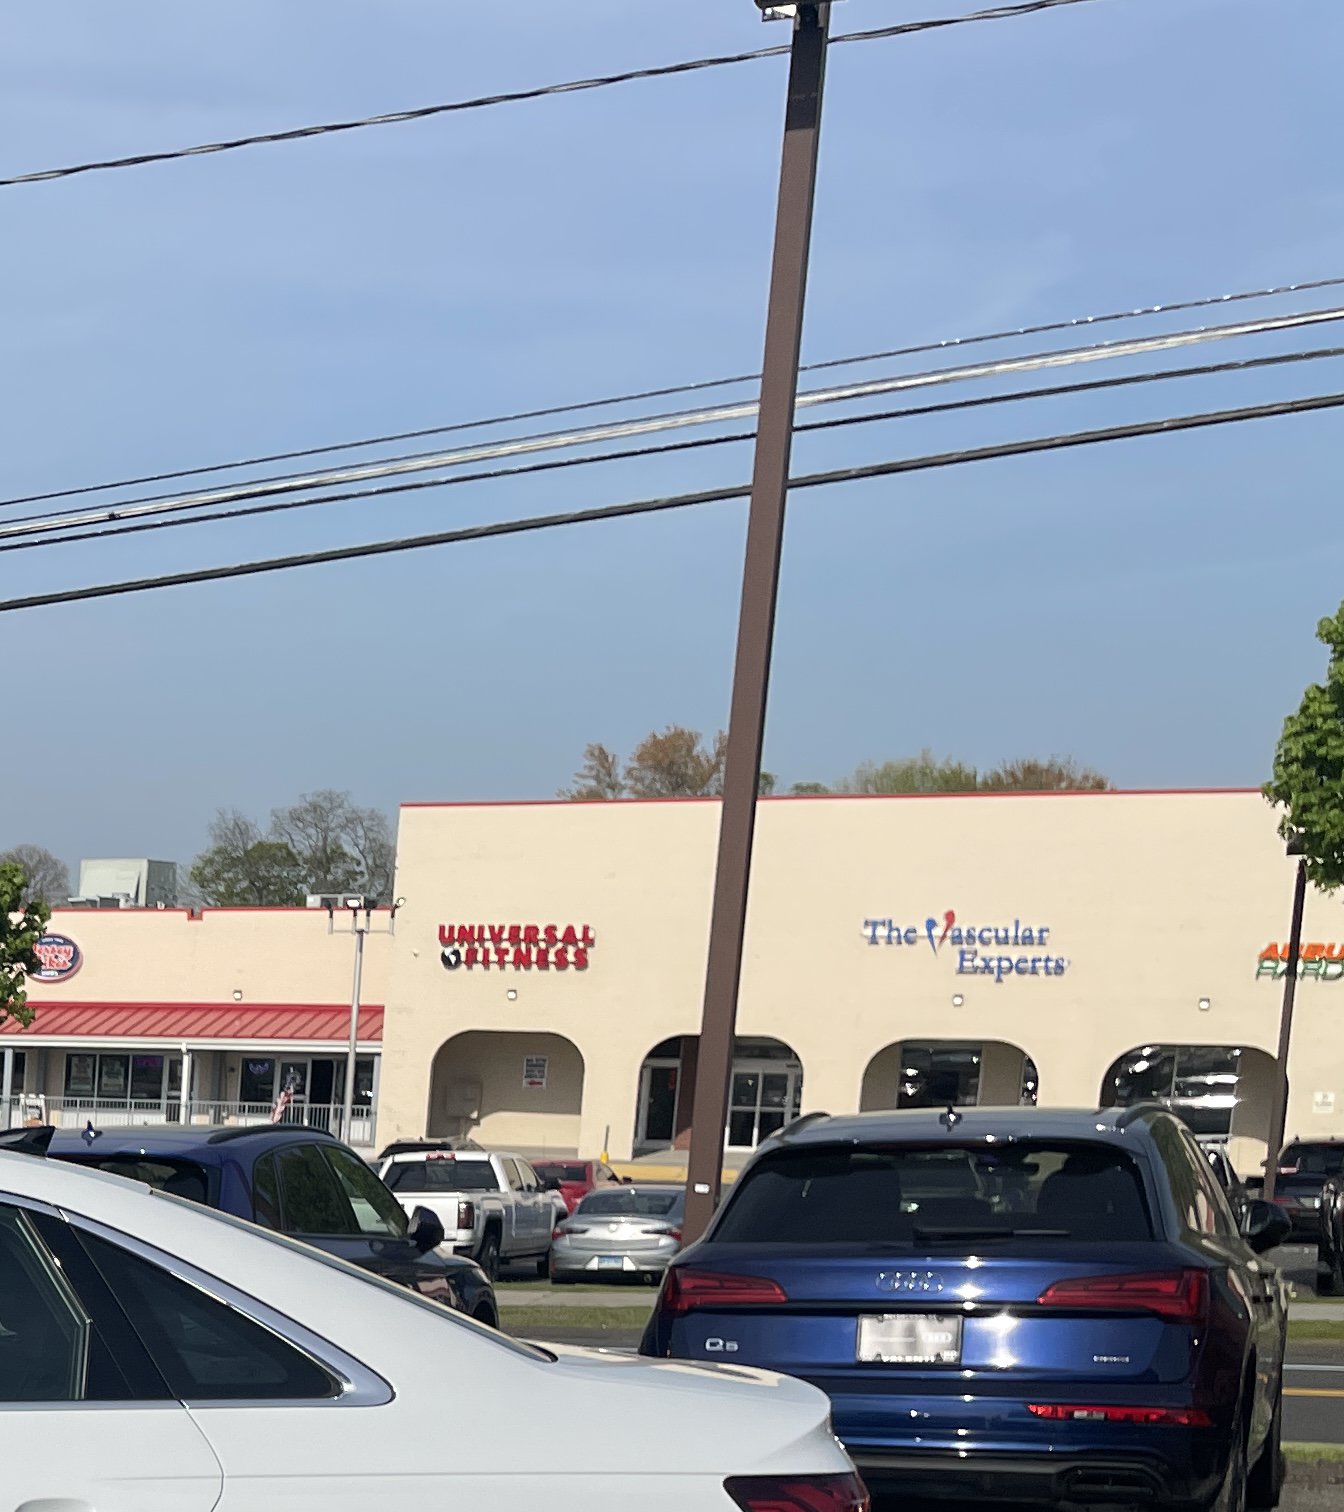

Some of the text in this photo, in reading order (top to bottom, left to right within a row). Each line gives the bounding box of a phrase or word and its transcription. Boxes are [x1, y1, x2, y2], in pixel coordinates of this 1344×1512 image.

[438, 924, 595, 946] UNIVERSAL
[863, 910, 1050, 957] The Vascular
[464, 946, 589, 970] FITNESS
[955, 948, 1066, 983] Experts
